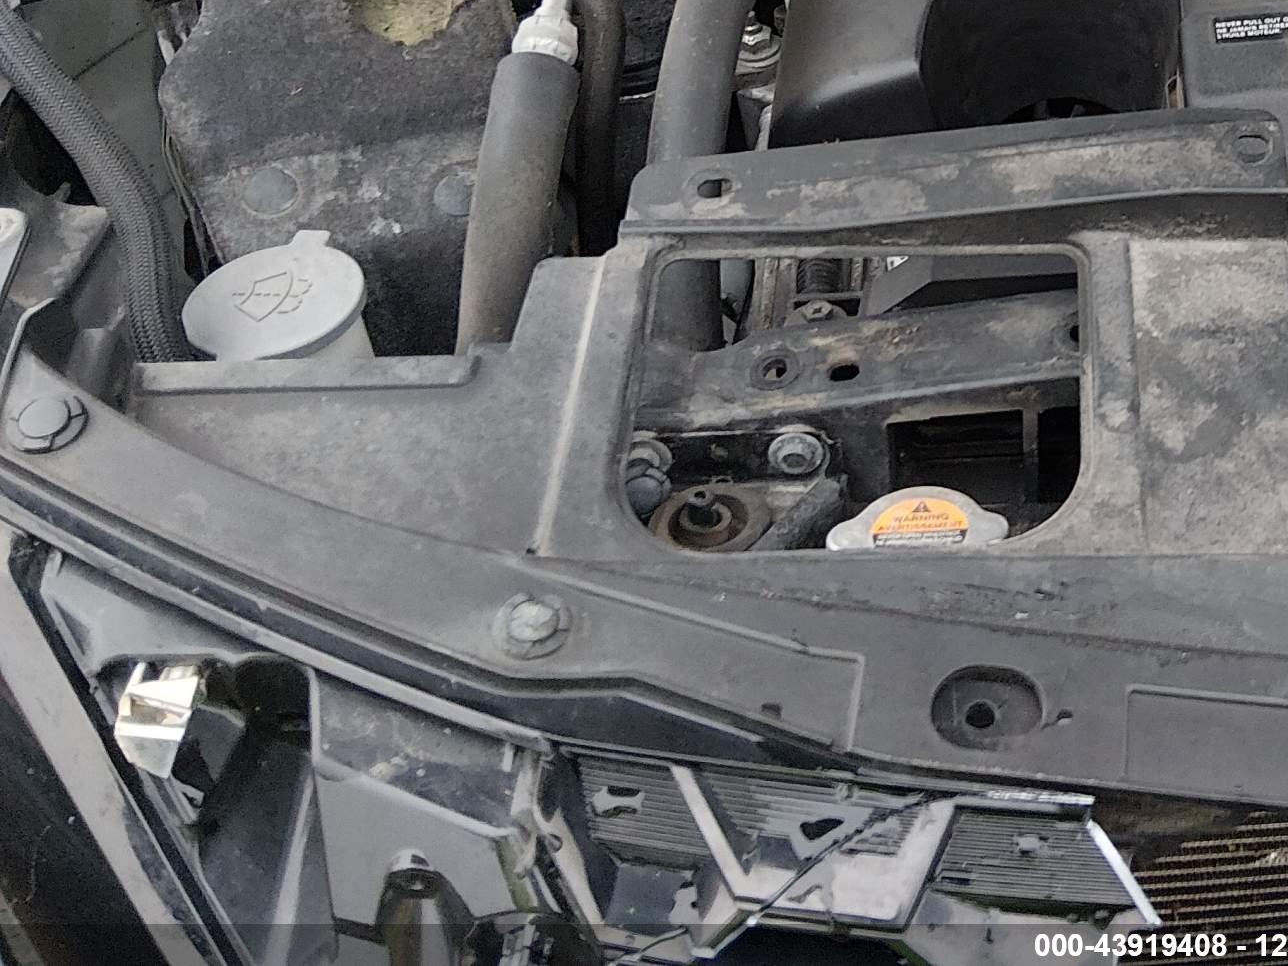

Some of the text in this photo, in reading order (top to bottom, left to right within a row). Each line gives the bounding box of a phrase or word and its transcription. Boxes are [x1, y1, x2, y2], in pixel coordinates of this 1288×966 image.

[1215, 20, 1242, 29] NEVER
[1243, 18, 1262, 26] PULL
[1229, 25, 1258, 33] JAMAIS
[894, 513, 949, 523] WARNING
